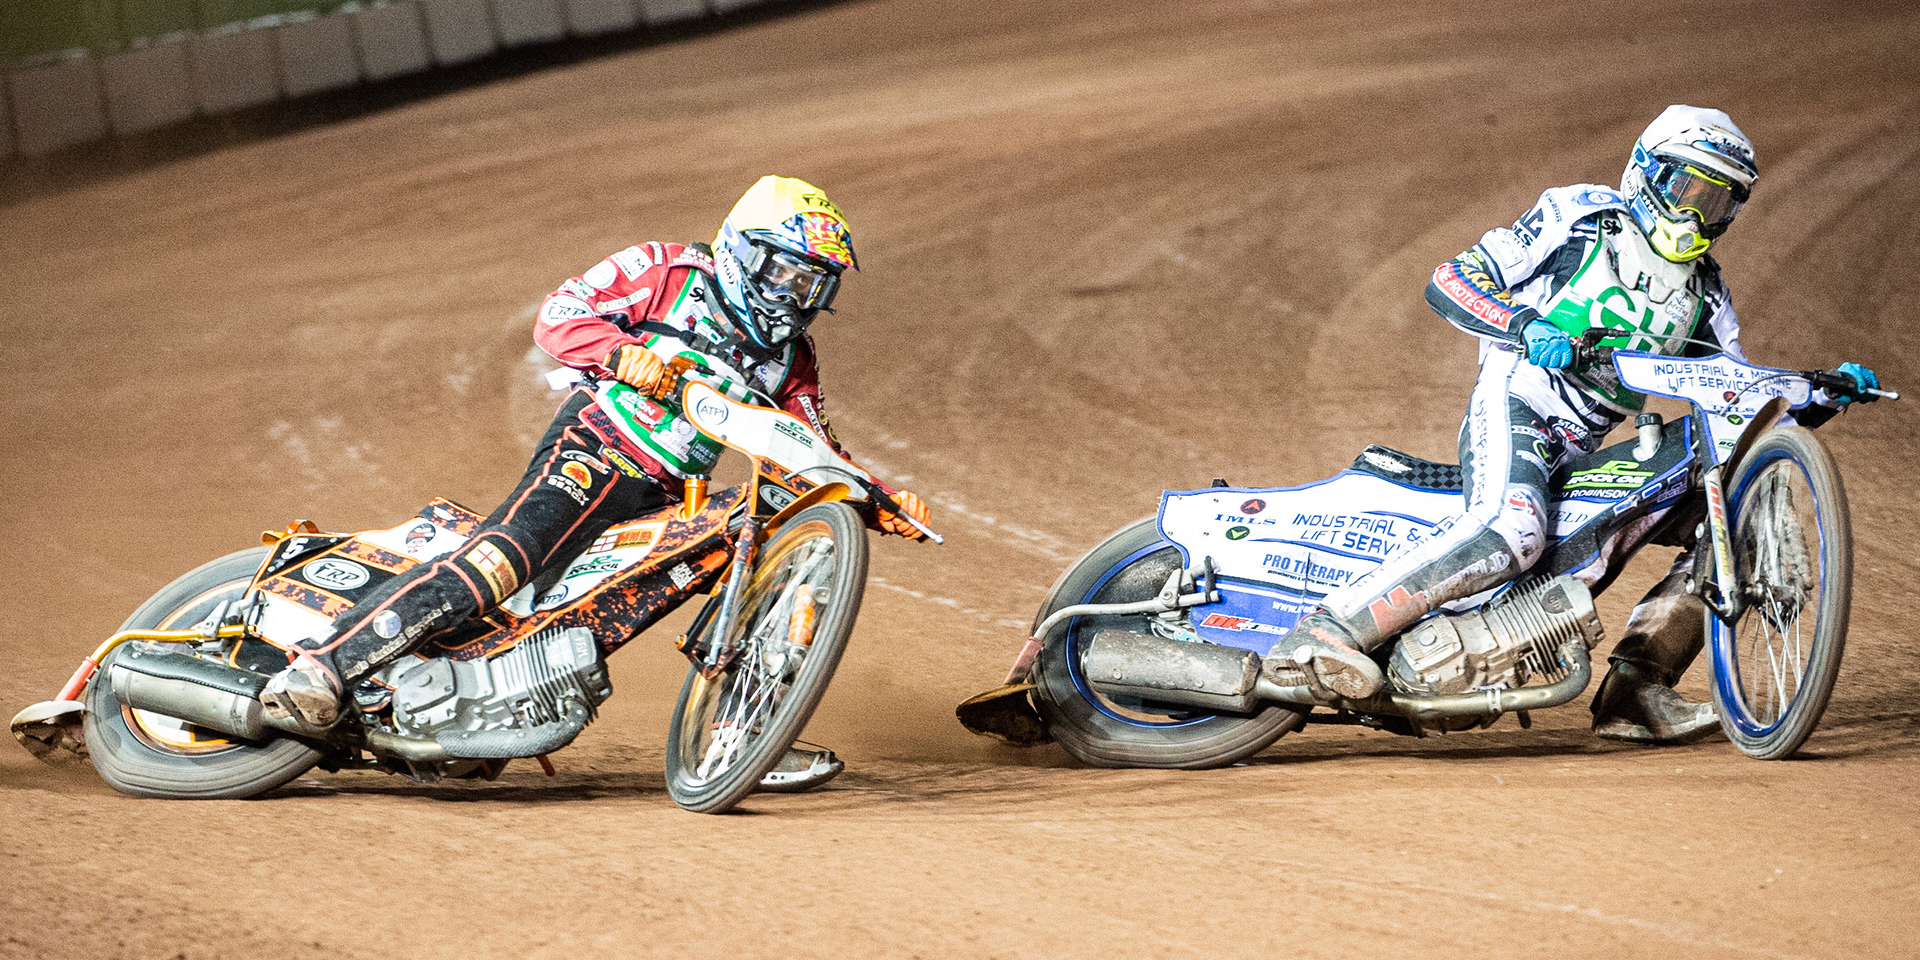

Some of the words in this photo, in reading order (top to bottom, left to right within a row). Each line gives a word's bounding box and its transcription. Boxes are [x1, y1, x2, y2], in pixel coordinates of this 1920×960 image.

[1444, 279, 1506, 324] PROTECTION
[1654, 363, 1729, 377] INDUSTRIAL
[1734, 368, 1744, 378] &
[1667, 376, 1695, 390] LIFT
[1698, 376, 1760, 393] SERVICES
[774, 422, 798, 438] ROCK
[799, 435, 814, 446] OIL
[1566, 474, 1616, 485] ROCK
[1616, 474, 1647, 485] OIL
[1569, 488, 1631, 499] ROBINSON
[1214, 513, 1277, 526] IMLS
[1292, 512, 1397, 538] INDUSTRIAL
[1406, 527, 1422, 542] &
[1300, 529, 1341, 545] LIFT
[281, 537, 309, 560] 5
[1262, 553, 1292, 570] PRO
[1293, 559, 1354, 583] THERAPY
